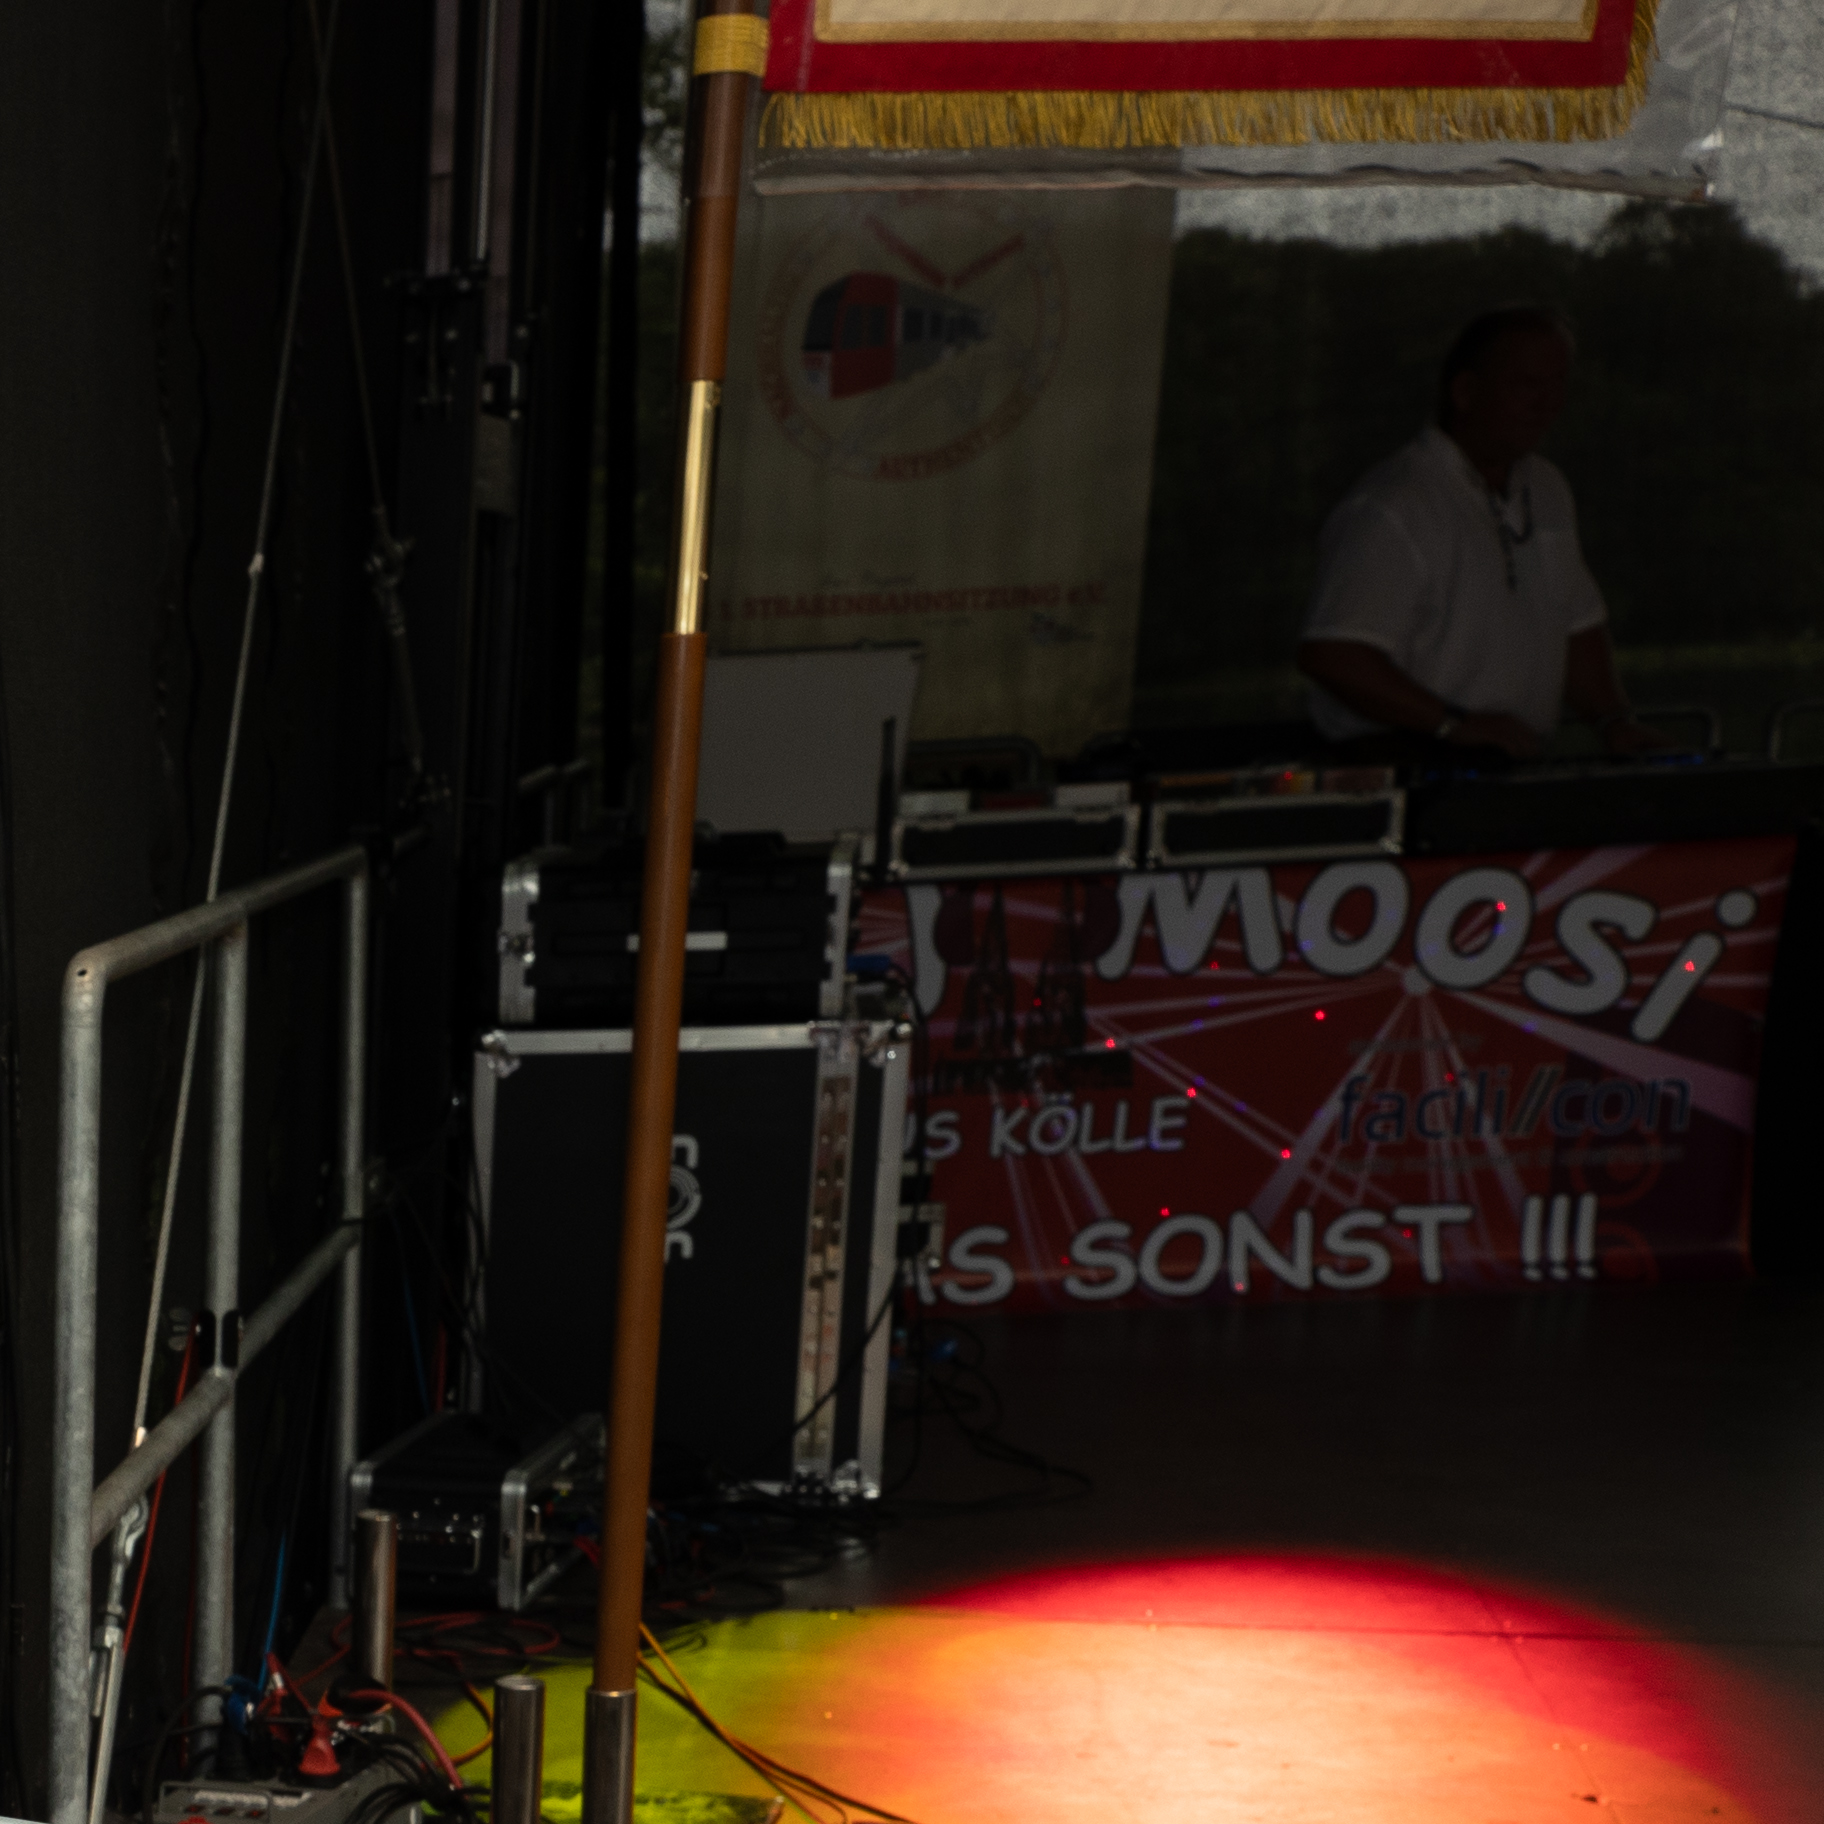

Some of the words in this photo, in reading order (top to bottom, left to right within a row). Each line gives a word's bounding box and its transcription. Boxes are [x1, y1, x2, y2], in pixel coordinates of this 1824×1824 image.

[988, 1091, 1191, 1158] KÖLLE
[1060, 1203, 1474, 1303] SONST
[1519, 1190, 1602, 1283] !!!
